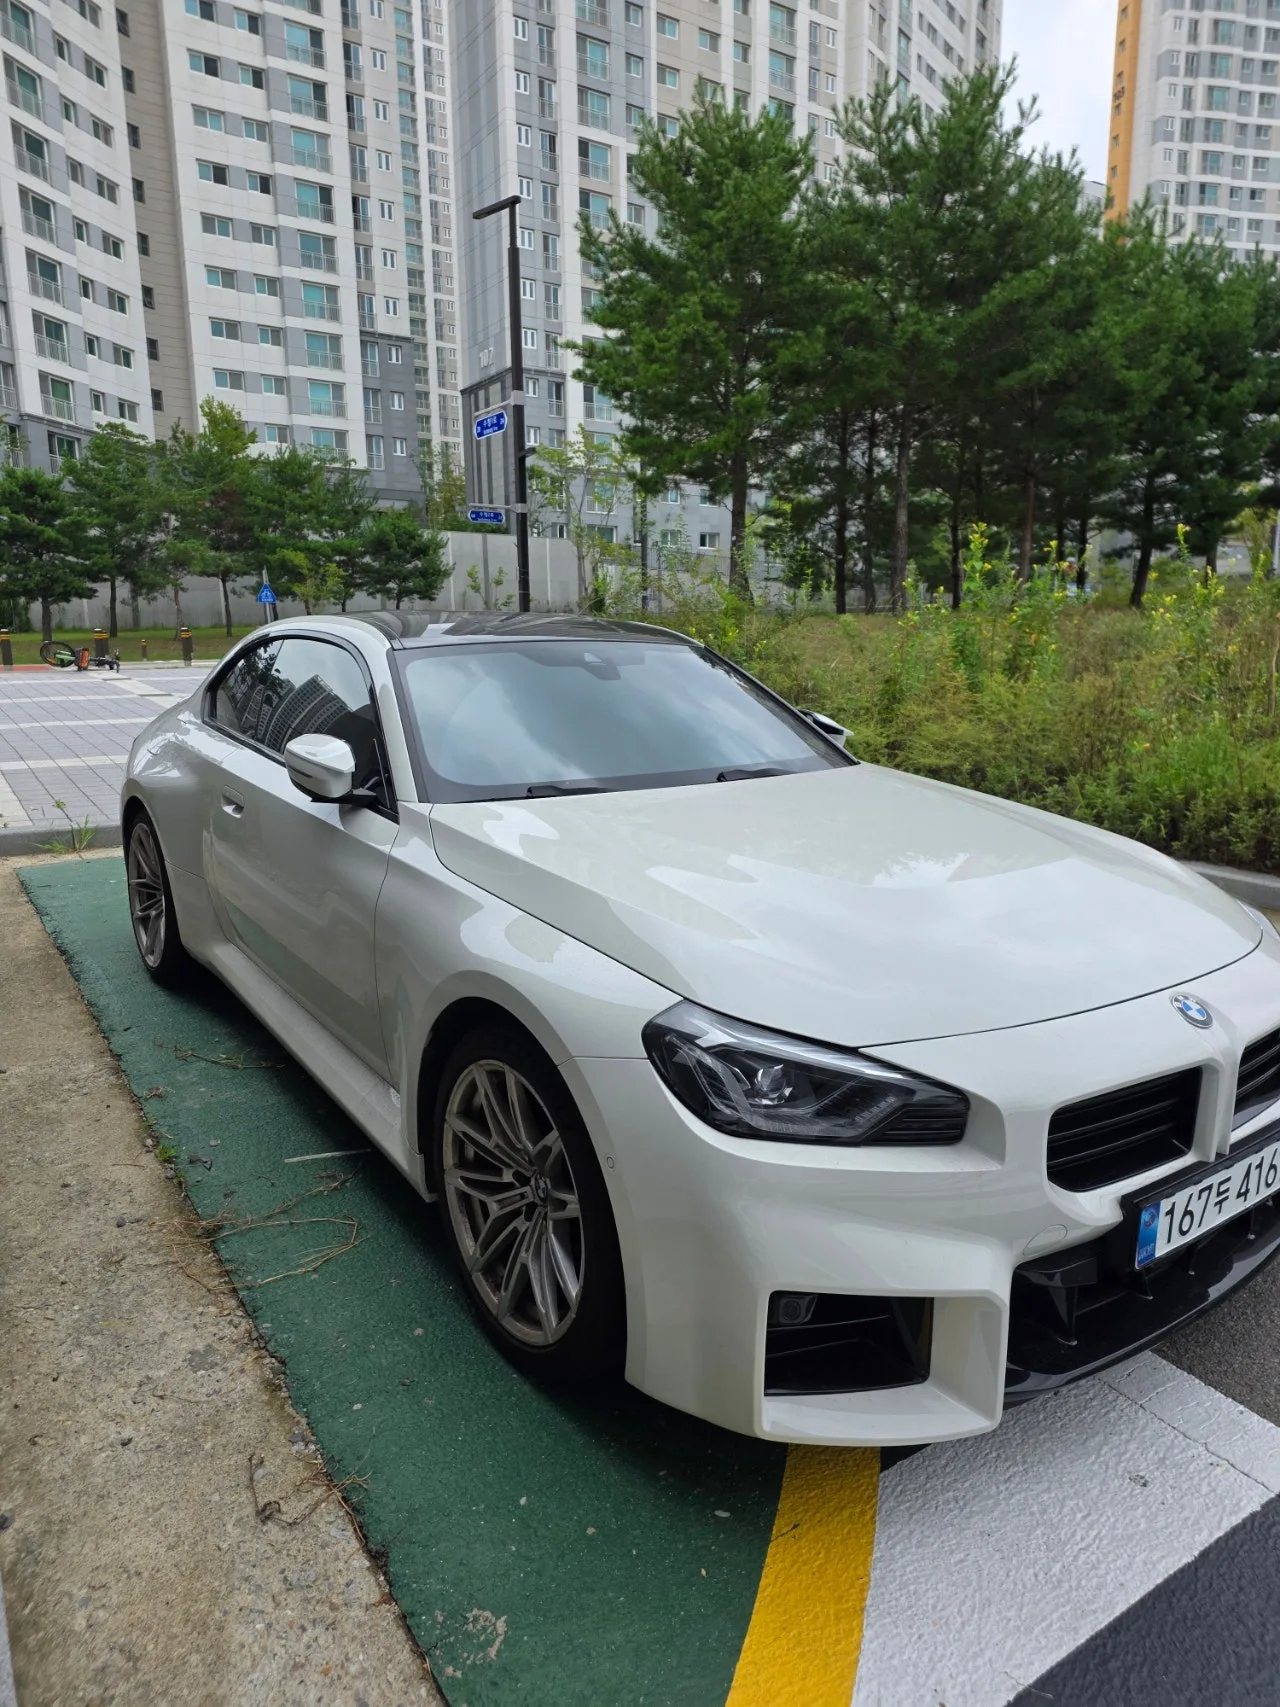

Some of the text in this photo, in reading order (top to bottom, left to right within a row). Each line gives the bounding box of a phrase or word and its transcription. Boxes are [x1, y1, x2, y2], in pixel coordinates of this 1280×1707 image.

[480, 347, 494, 368] 102
[1164, 1147, 1280, 1244] 167두 416
